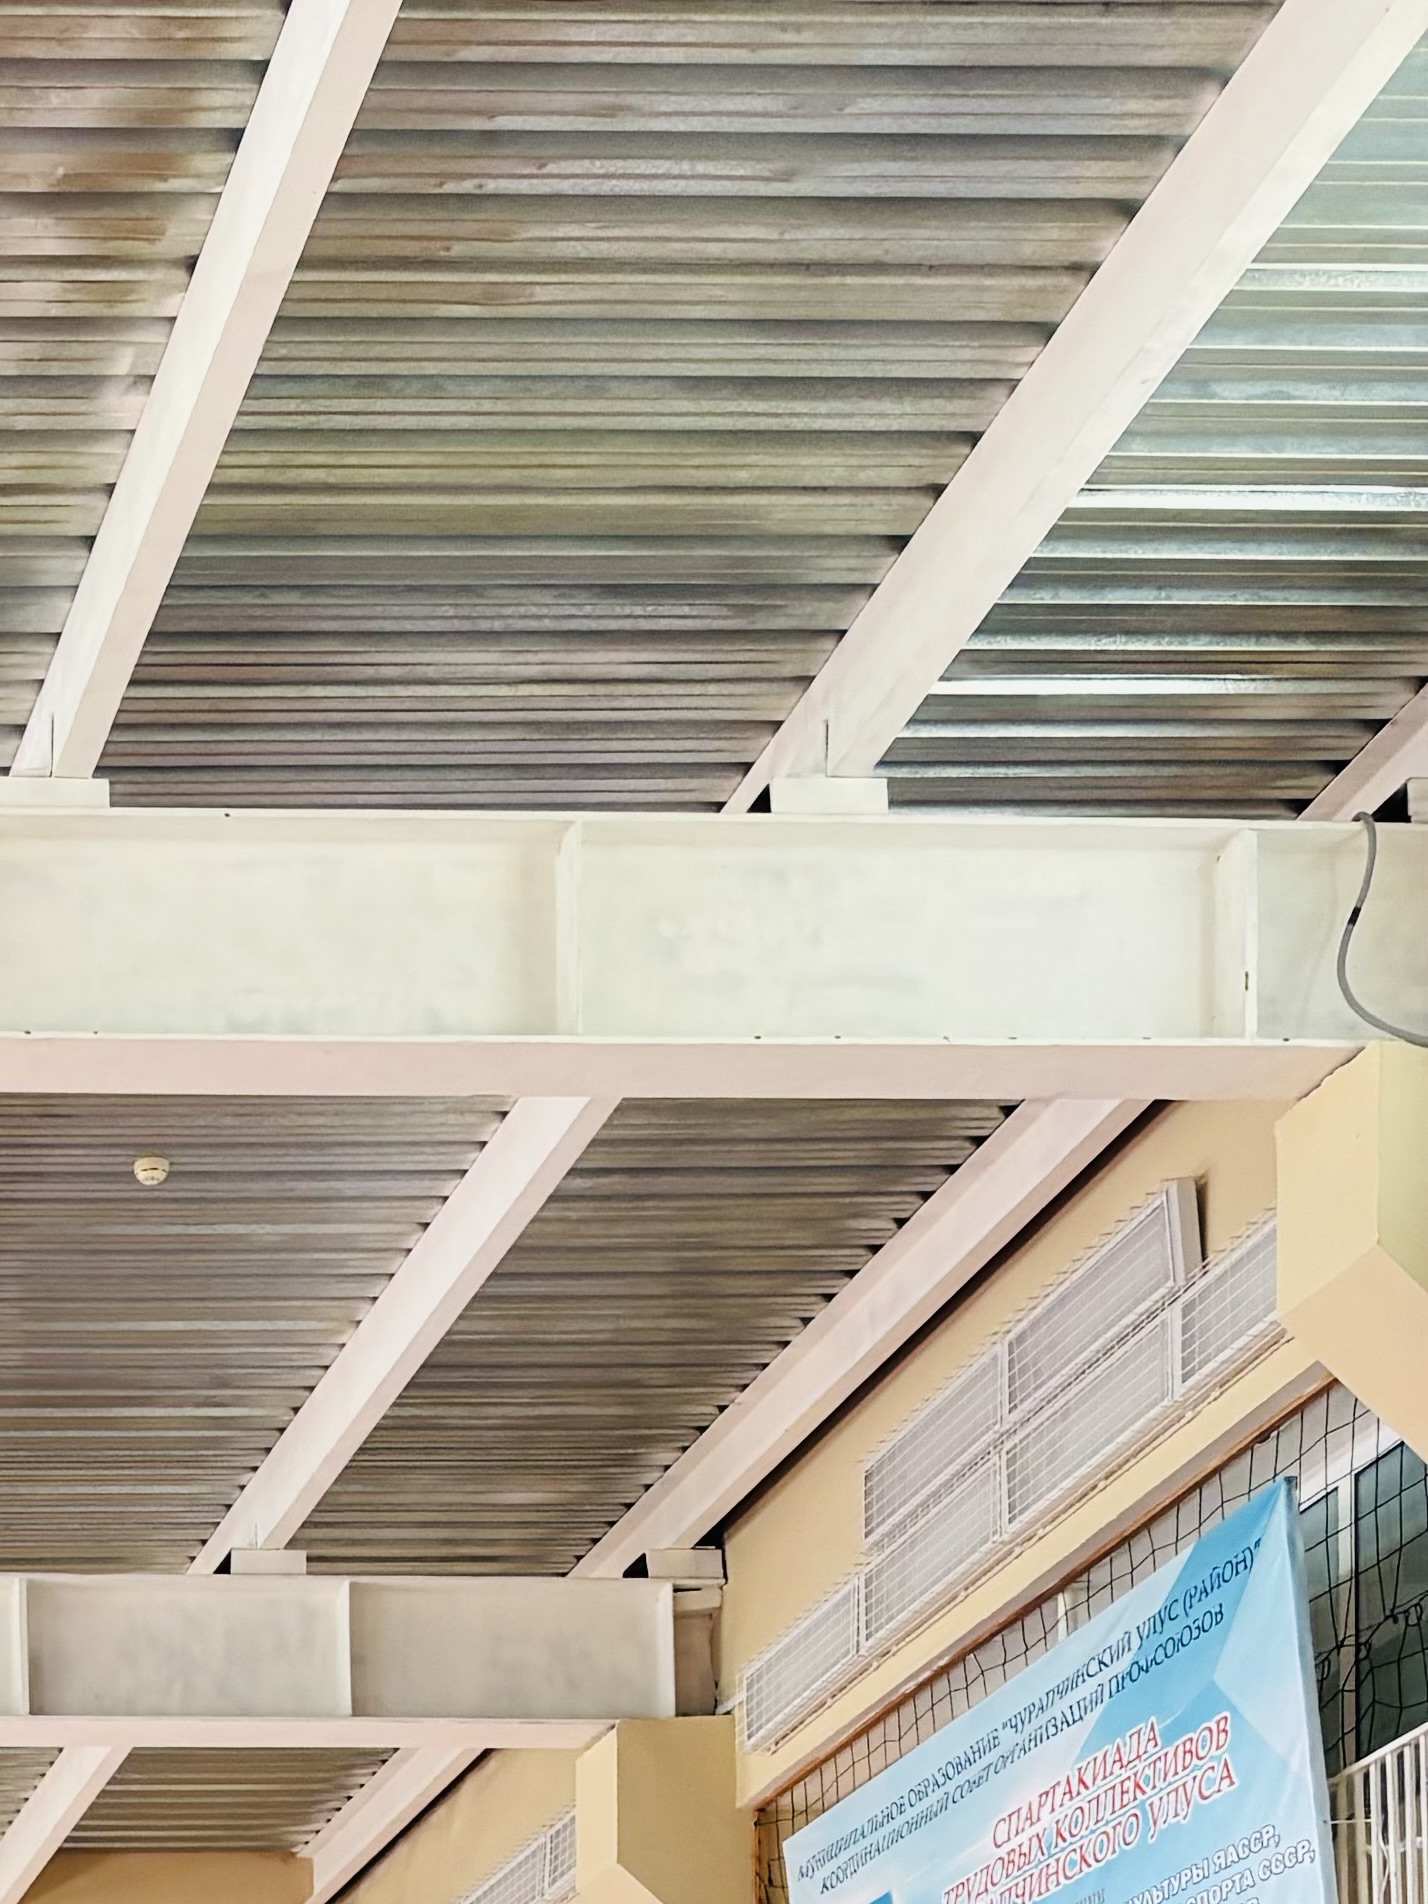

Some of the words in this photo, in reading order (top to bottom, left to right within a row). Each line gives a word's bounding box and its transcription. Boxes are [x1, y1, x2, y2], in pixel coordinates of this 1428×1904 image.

[908, 1728, 1000, 1808] ОБРАЗОВАНИЕ
[1136, 1599, 1180, 1650] УЛУС
[994, 1683, 1104, 1775] ОРГАНИЗАЦИЙ
[993, 1720, 1159, 1848] СПАРТАКИАДА
[1053, 1715, 1230, 1850] КОЛЛЕКТИВОВ
[1148, 1757, 1235, 1840] УЛУСА
[1213, 1824, 1280, 1873] ЯАССР,
[1258, 1840, 1315, 1882] СССР,
